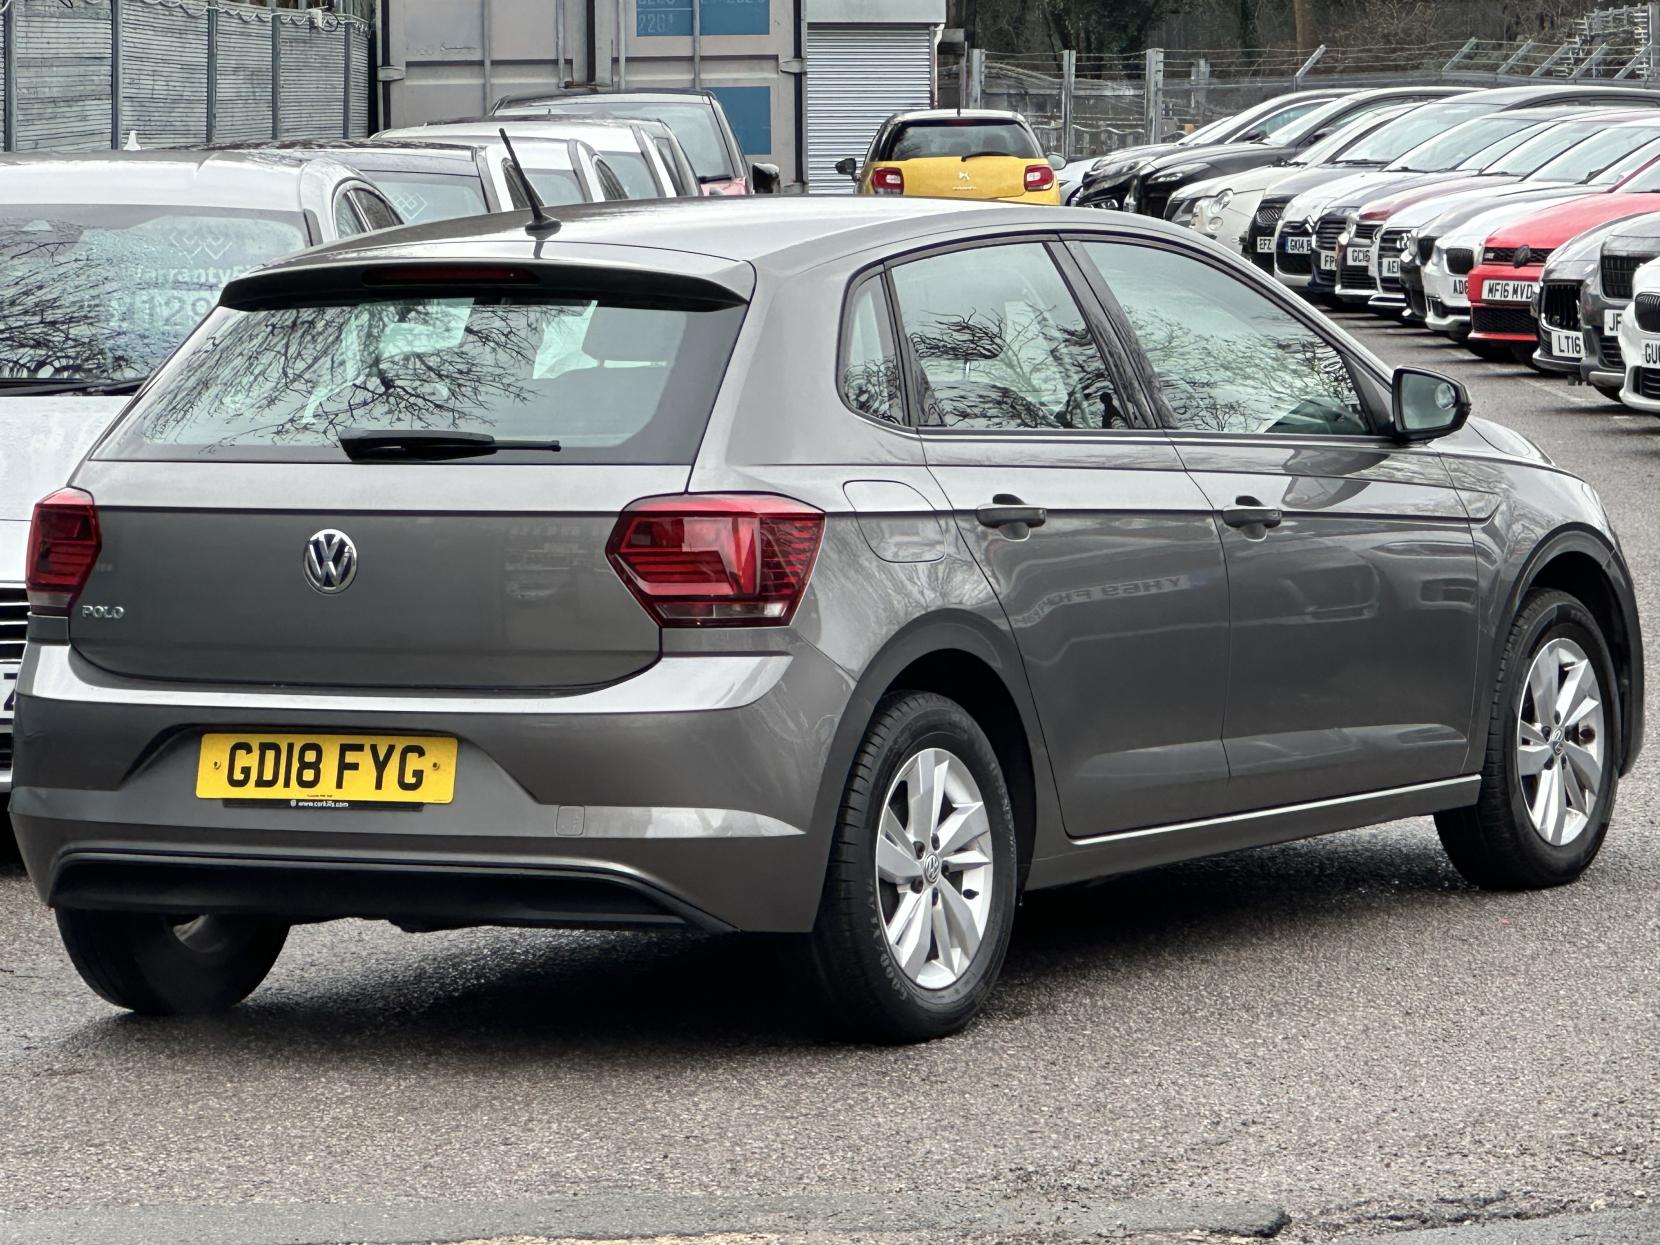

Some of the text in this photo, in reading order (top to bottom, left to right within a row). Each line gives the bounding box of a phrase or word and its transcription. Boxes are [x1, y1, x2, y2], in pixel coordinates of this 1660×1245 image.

[1487, 281, 1533, 300] MF16 MVD
[1558, 335, 1581, 354] LT16
[82, 605, 125, 619] POLO
[226, 742, 426, 792] GD18 FYG
